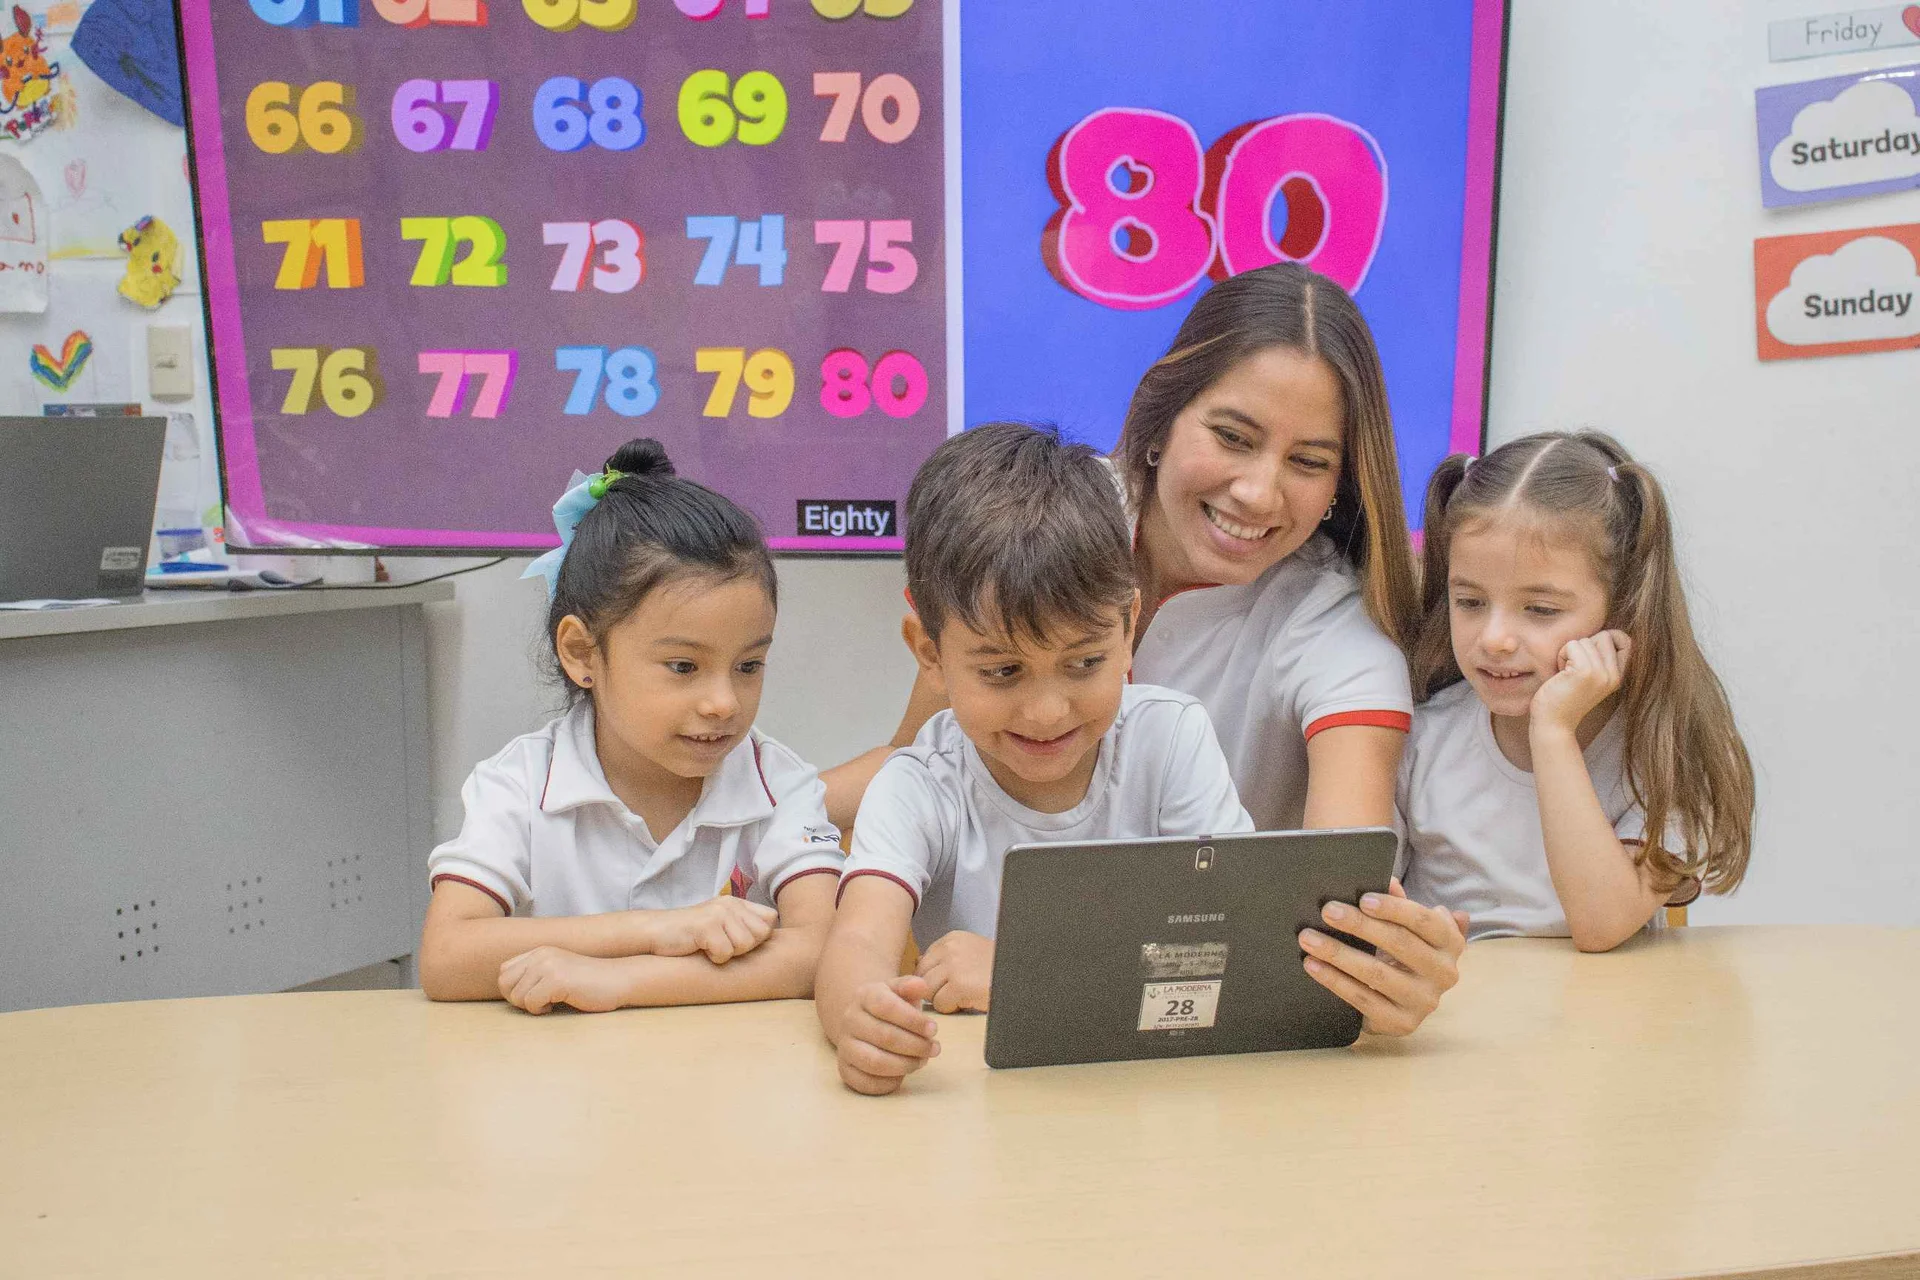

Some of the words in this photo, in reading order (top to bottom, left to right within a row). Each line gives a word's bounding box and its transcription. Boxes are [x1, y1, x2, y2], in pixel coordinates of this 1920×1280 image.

[1805, 16, 1884, 46] Friday
[245, 80, 362, 154] 66
[391, 78, 499, 153] 67
[532, 75, 647, 153] 68
[677, 69, 788, 147] 69
[812, 72, 921, 144] 70
[1791, 128, 1920, 166] Saturday
[1040, 106, 1390, 311] 80
[261, 218, 365, 290] 71
[400, 215, 509, 287] 72
[542, 218, 647, 294] 73
[685, 213, 788, 287] 74
[813, 219, 918, 294] 75
[1804, 289, 1913, 318] Sunday
[270, 346, 381, 418] 76
[417, 348, 519, 419] 77
[555, 345, 661, 417] 78
[695, 347, 795, 418] 79
[819, 347, 929, 418] 80
[804, 504, 891, 536] Eighty
[1167, 913, 1225, 924] SAMSUNG
[1175, 984, 1213, 993] MODERNA
[1165, 999, 1195, 1017] 28
